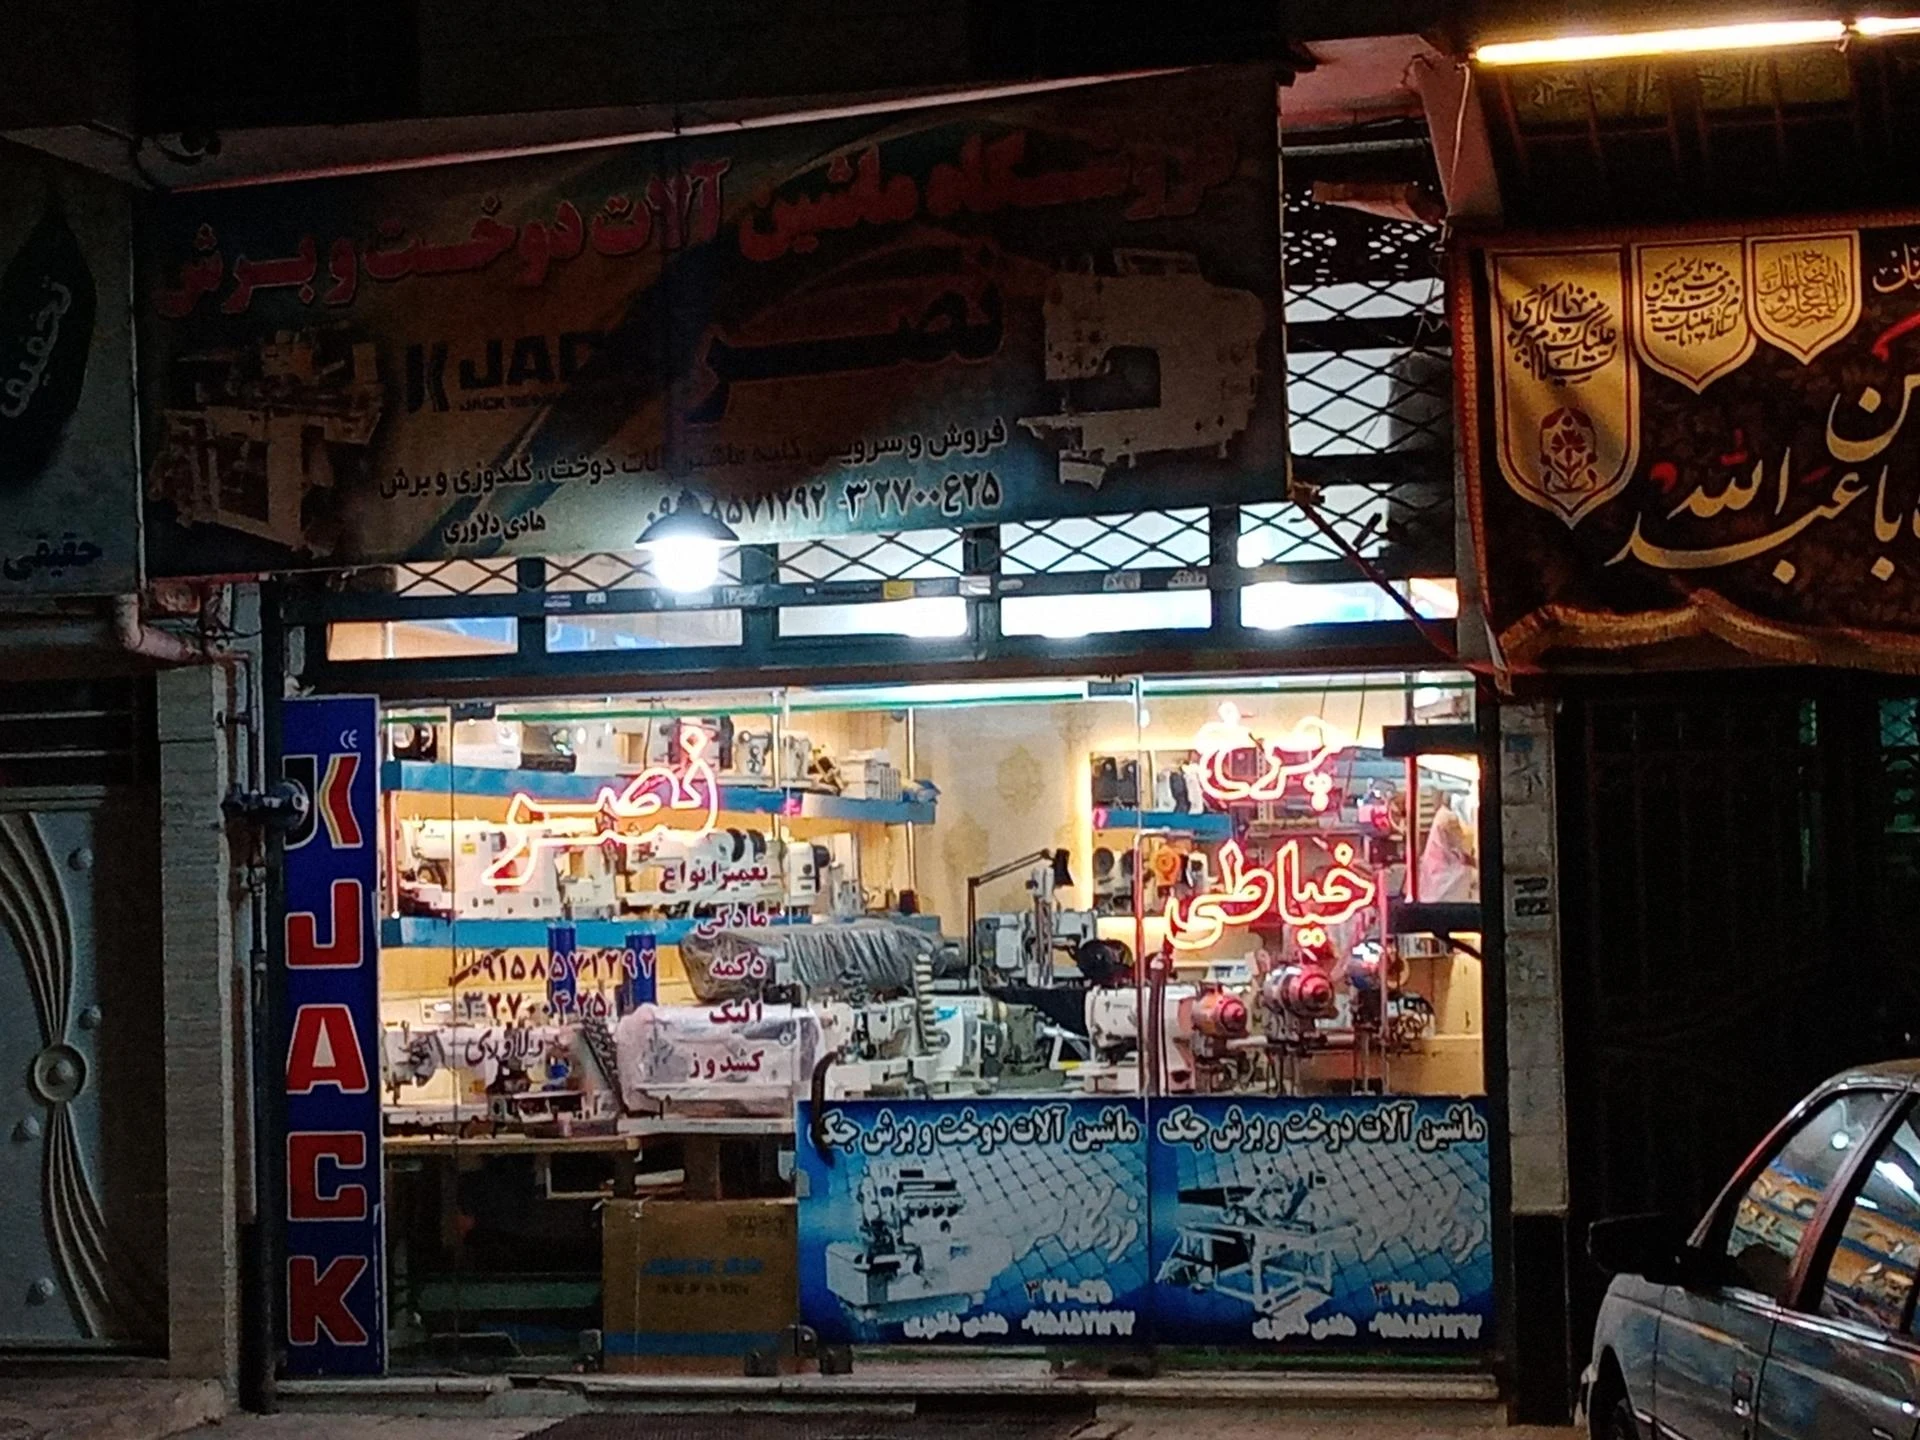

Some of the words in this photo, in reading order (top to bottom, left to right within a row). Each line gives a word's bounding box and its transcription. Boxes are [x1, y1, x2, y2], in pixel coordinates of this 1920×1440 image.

[364, 195, 585, 288] دوخت
[152, 222, 317, 319] برش
[328, 236, 358, 307] و
[907, 432, 923, 459] و
[928, 417, 1005, 457] فروش
[378, 467, 432, 500] برش
[435, 472, 448, 496] و
[550, 453, 616, 485] دوخت
[443, 512, 500, 545] دلاوری
[503, 510, 546, 541] هادی
[1163, 838, 1376, 950] خیاطی
[284, 877, 370, 1348] JACK
[809, 1109, 860, 1151] جک
[861, 1110, 916, 1154] برش
[935, 1107, 1009, 1153] دوخت
[1010, 1104, 1071, 1144] آلات
[1069, 1106, 1139, 1152] ماشین
[1160, 1106, 1209, 1151] جک
[1210, 1106, 1265, 1152] برش
[1283, 1107, 1356, 1152] دوخت
[1357, 1101, 1415, 1143] آلات
[1416, 1104, 1486, 1152] ماشین
[918, 1122, 934, 1153] و
[1266, 1120, 1282, 1152] و
